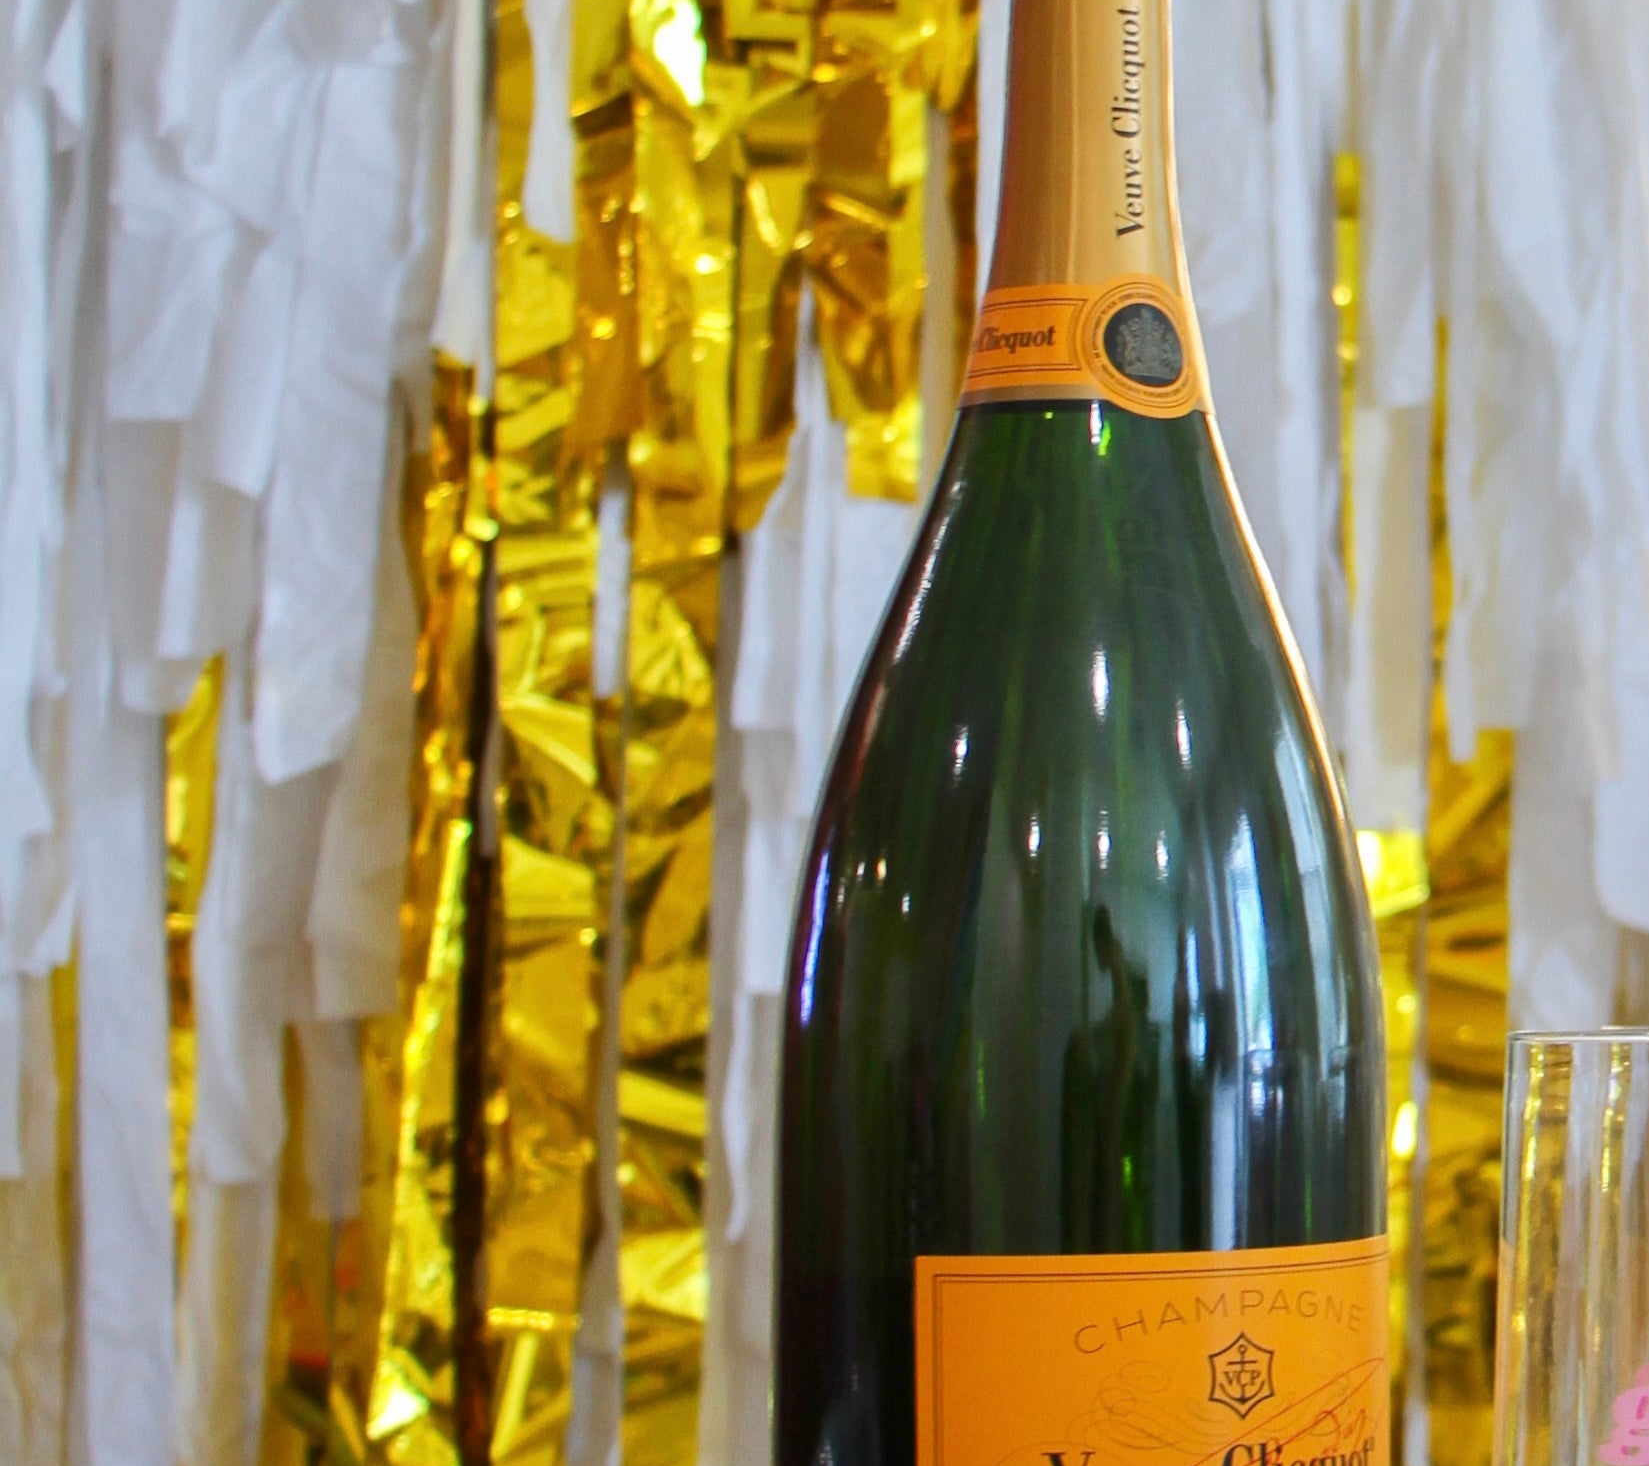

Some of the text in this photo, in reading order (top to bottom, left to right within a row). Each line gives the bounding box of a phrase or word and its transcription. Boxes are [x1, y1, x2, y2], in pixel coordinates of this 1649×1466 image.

[1110, 7, 1146, 237] Veuve Clicquot
[1073, 1289, 1364, 1355] CHAMPAGNE
